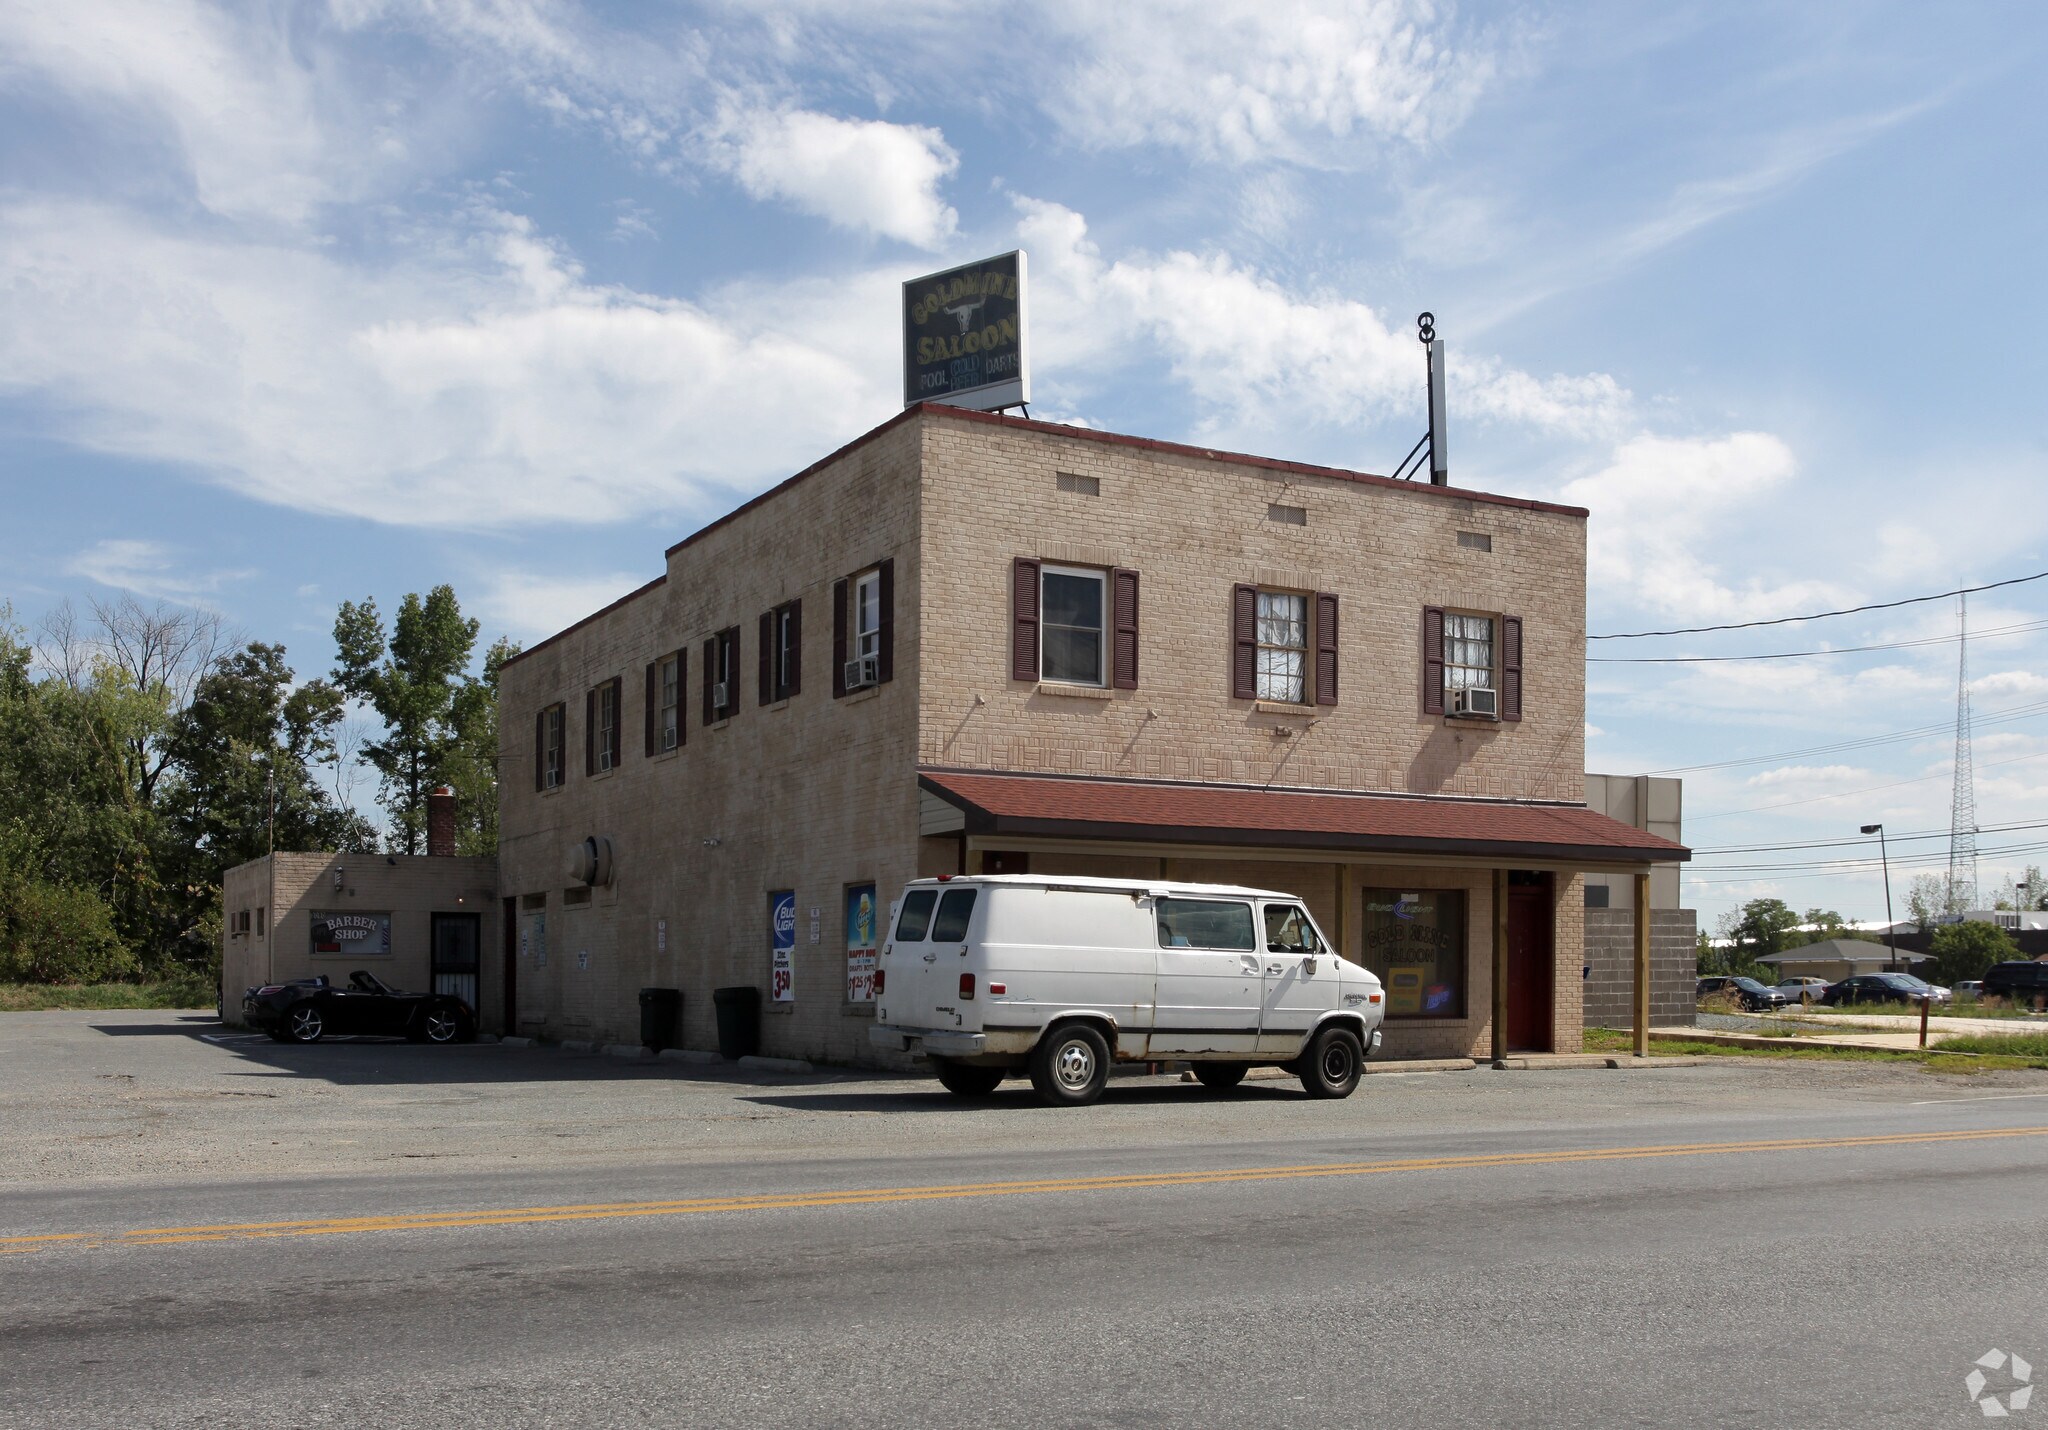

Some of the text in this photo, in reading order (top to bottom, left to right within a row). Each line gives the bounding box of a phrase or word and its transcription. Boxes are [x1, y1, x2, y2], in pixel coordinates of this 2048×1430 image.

[917, 313, 1017, 365] SALOON
[920, 370, 948, 391] POOL
[326, 915, 377, 931] BARBER
[776, 920, 795, 931] LIGH
[335, 929, 367, 940] SHOP
[1367, 924, 1450, 949] GOLD MINE
[1383, 947, 1435, 962] SALOON
